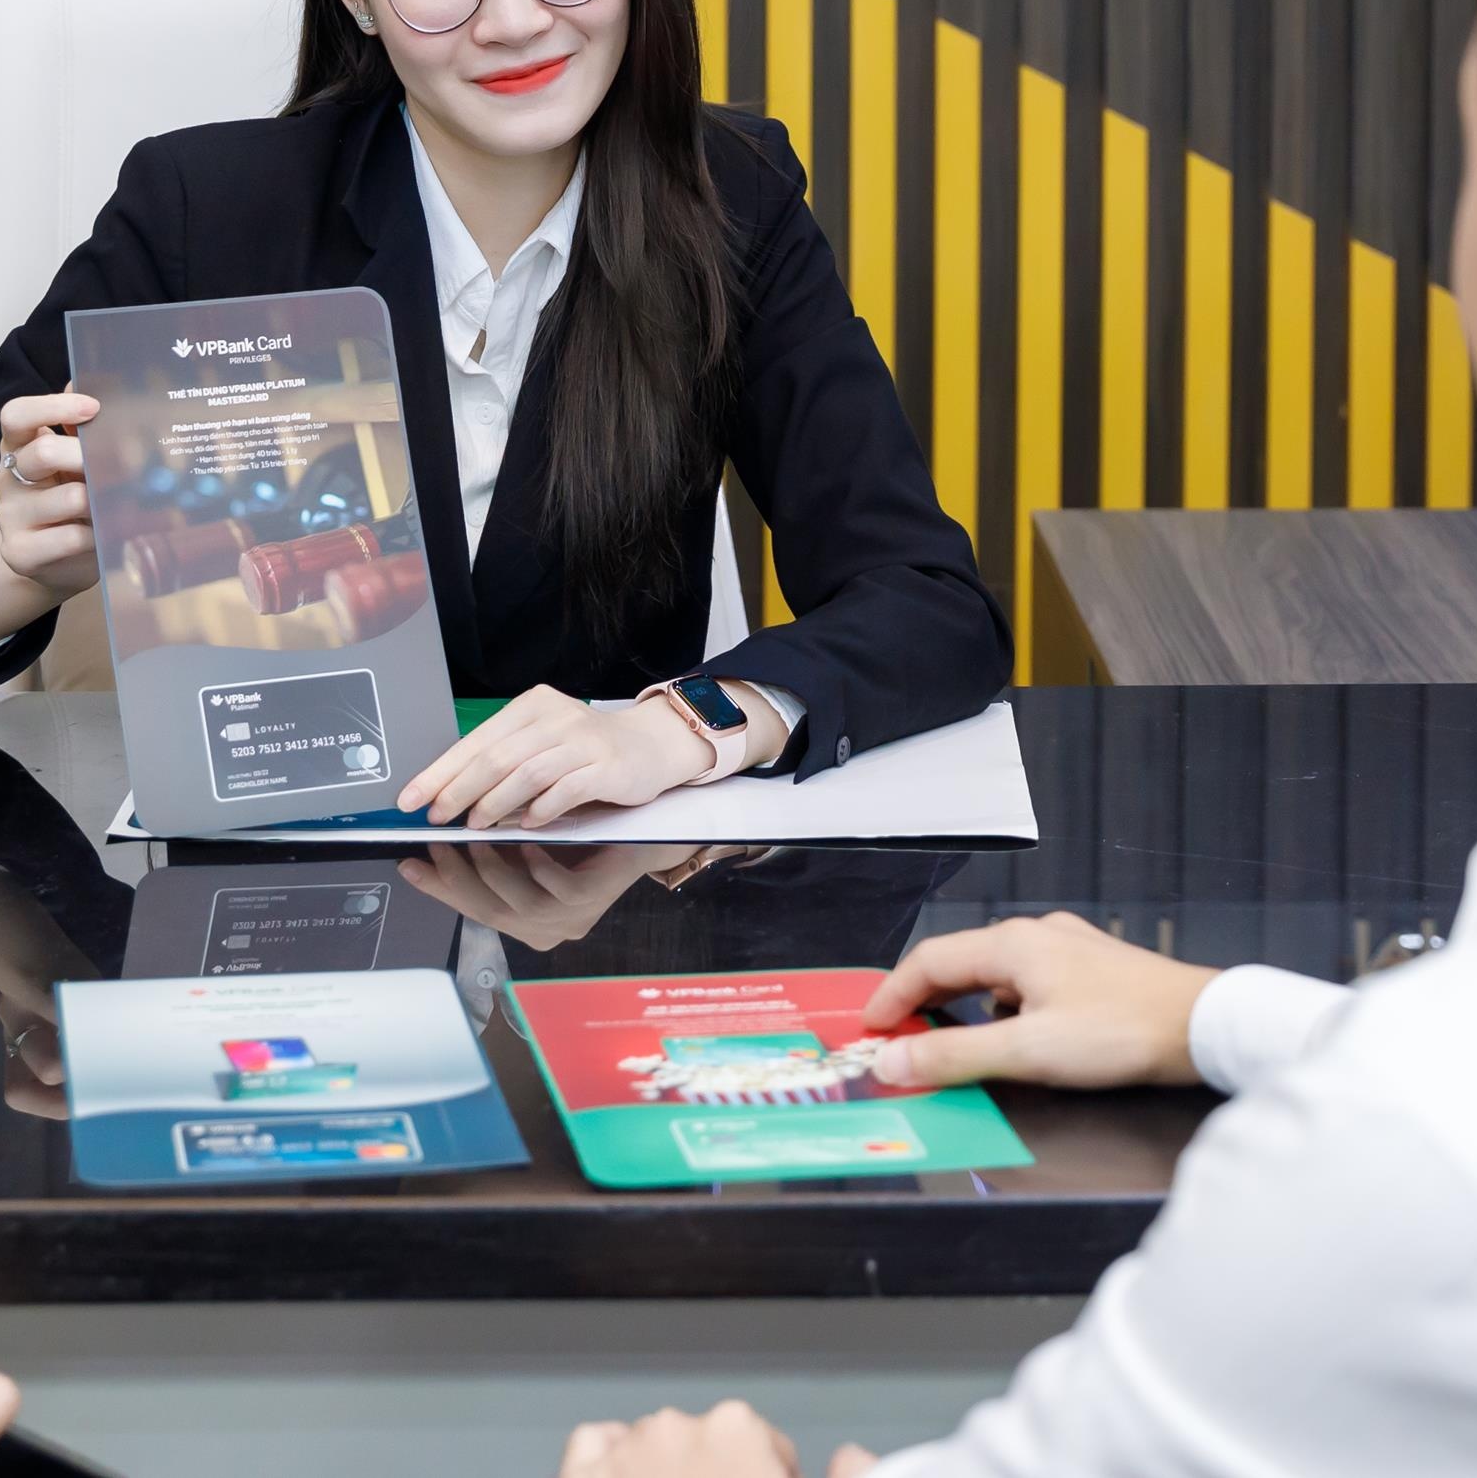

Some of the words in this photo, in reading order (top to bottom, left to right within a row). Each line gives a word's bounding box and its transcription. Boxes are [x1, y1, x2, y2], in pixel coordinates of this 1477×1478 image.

[196, 338, 255, 357] VPBank
[257, 334, 292, 351] Card
[229, 354, 272, 364] PRIVILEGES
[229, 382, 266, 393] VPBANK
[208, 393, 269, 406] MASTERCARD
[256, 449, 265, 458] 40
[260, 460, 270, 469] 15
[225, 692, 262, 705] VPBank
[255, 722, 296, 734] LOYALTY
[231, 745, 256, 758] 5203
[259, 742, 282, 754] 7512
[285, 739, 308, 751] 3412
[311, 736, 336, 748] 3412
[338, 732, 362, 745] 3456
